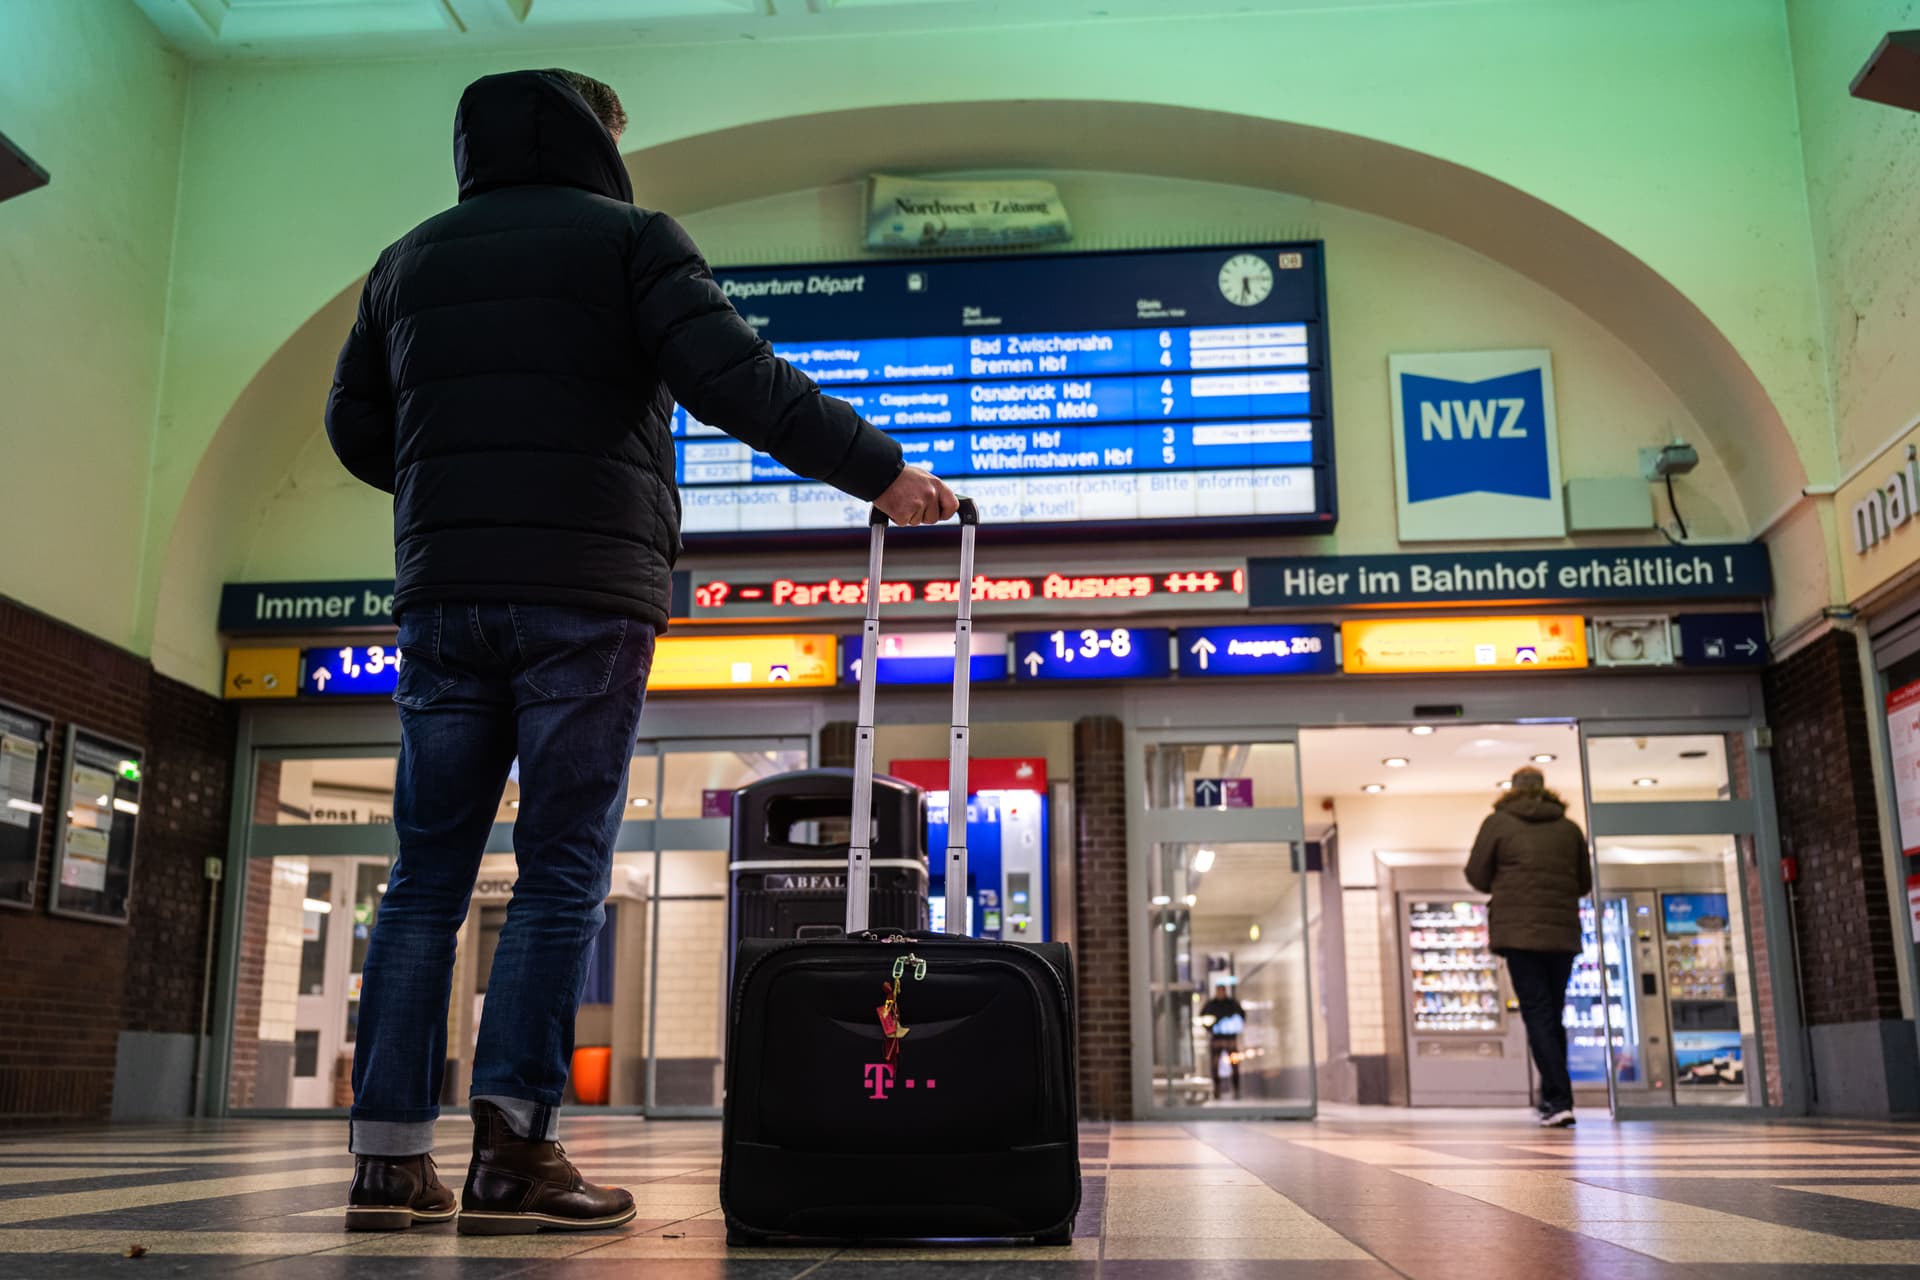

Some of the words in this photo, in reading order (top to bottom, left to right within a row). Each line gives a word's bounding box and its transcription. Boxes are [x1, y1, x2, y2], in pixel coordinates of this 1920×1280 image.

[896, 197, 976, 215] Nordwest
[992, 200, 1050, 214] Zeitung
[722, 279, 804, 299] Departure
[807, 274, 864, 296] Départ
[971, 337, 1001, 355] Bad
[1008, 335, 1112, 353] Zwischenahn
[1160, 331, 1171, 348] 6
[971, 358, 1033, 374] Bremen
[1039, 355, 1066, 371] Hbf
[1160, 350, 1172, 367] 4
[971, 385, 1055, 402] Osnabrück
[1063, 382, 1091, 399] Hbf
[1161, 378, 1173, 395] 4
[971, 404, 1050, 421] Norddeich
[1056, 402, 1098, 418] Mole
[1162, 398, 1174, 415] 7
[1420, 397, 1528, 441] NWZ
[971, 434, 1027, 453] Leipzig
[1033, 432, 1060, 448] Hbf
[1163, 427, 1175, 445] 3
[971, 452, 1099, 470] Wilhelmshaven
[1104, 448, 1133, 465] Hbf
[1163, 446, 1175, 464] 5
[1150, 475, 1190, 491] Bitte
[1196, 472, 1292, 489] informieren
[1283, 567, 1350, 597] Hier
[1358, 566, 1401, 594] im
[1410, 561, 1549, 593] Bahnhof
[1558, 556, 1714, 589] erhältlich
[772, 579, 914, 606] Parteien
[1043, 572, 1153, 599] Ausweg
[256, 592, 356, 620] Immer
[1080, 628, 1132, 658] 3-8
[784, 876, 848, 889] ABFAL
